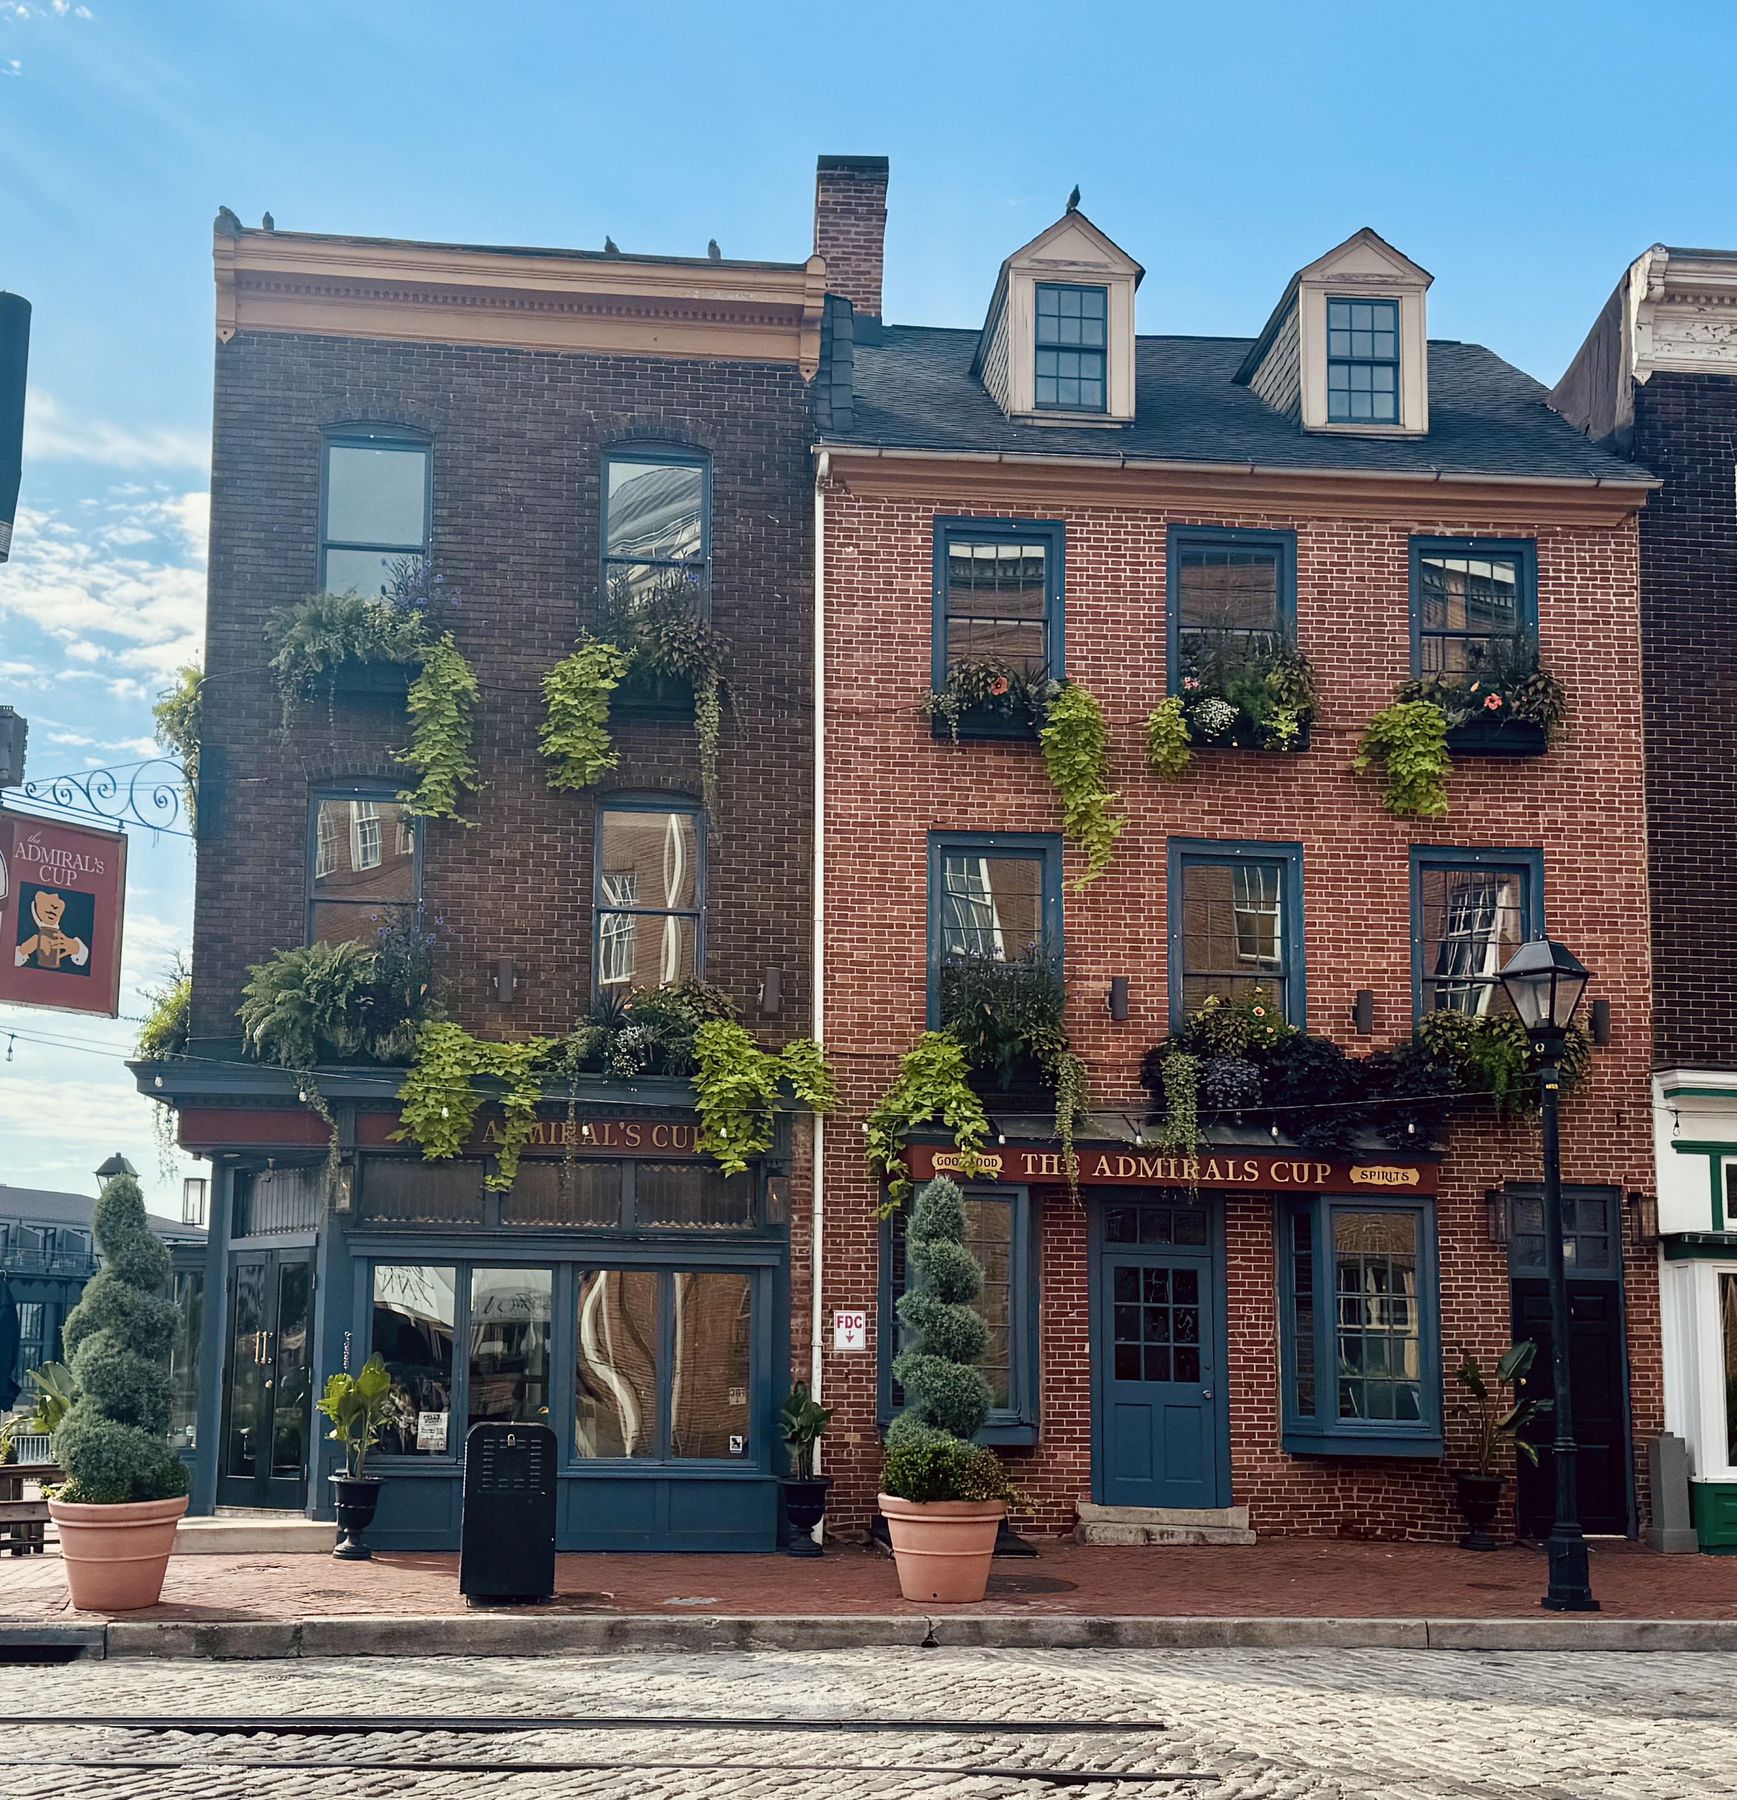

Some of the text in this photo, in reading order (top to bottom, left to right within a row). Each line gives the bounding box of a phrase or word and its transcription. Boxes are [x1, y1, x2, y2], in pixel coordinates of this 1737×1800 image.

[27, 831, 42, 844] the
[14, 842, 105, 875] ADMIRAL'S
[39, 864, 78, 887] CUP
[481, 1120, 641, 1147] AMIRAL'S
[936, 1156, 998, 1168] GOO OOD
[1091, 1155, 1259, 1182] ADMIRALS
[1270, 1161, 1331, 1184] CUP
[1360, 1170, 1410, 1182] SPIRITS
[837, 1315, 863, 1329] FDC
